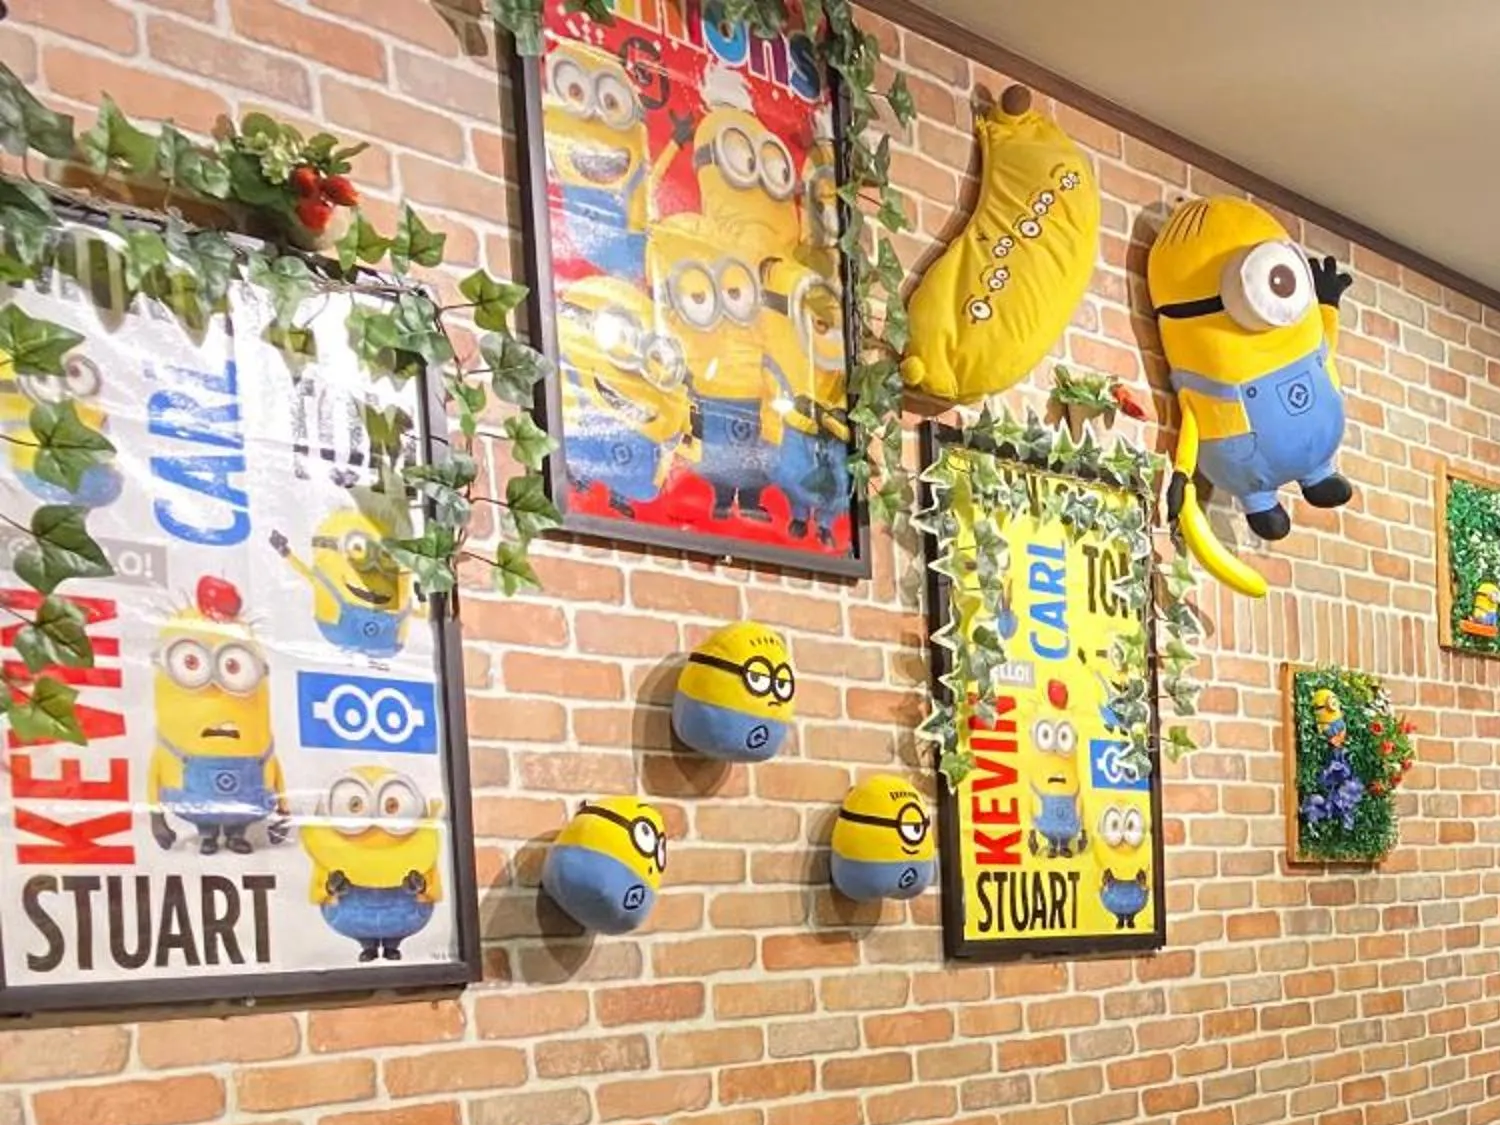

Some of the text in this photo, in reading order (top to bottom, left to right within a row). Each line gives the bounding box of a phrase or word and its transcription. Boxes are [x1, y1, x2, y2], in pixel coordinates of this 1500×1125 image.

[147, 359, 251, 546] CARL
[1027, 541, 1070, 660] CARL
[967, 692, 1023, 865] KEVIN
[25, 874, 277, 973] STUART
[976, 870, 1081, 933] STUART
